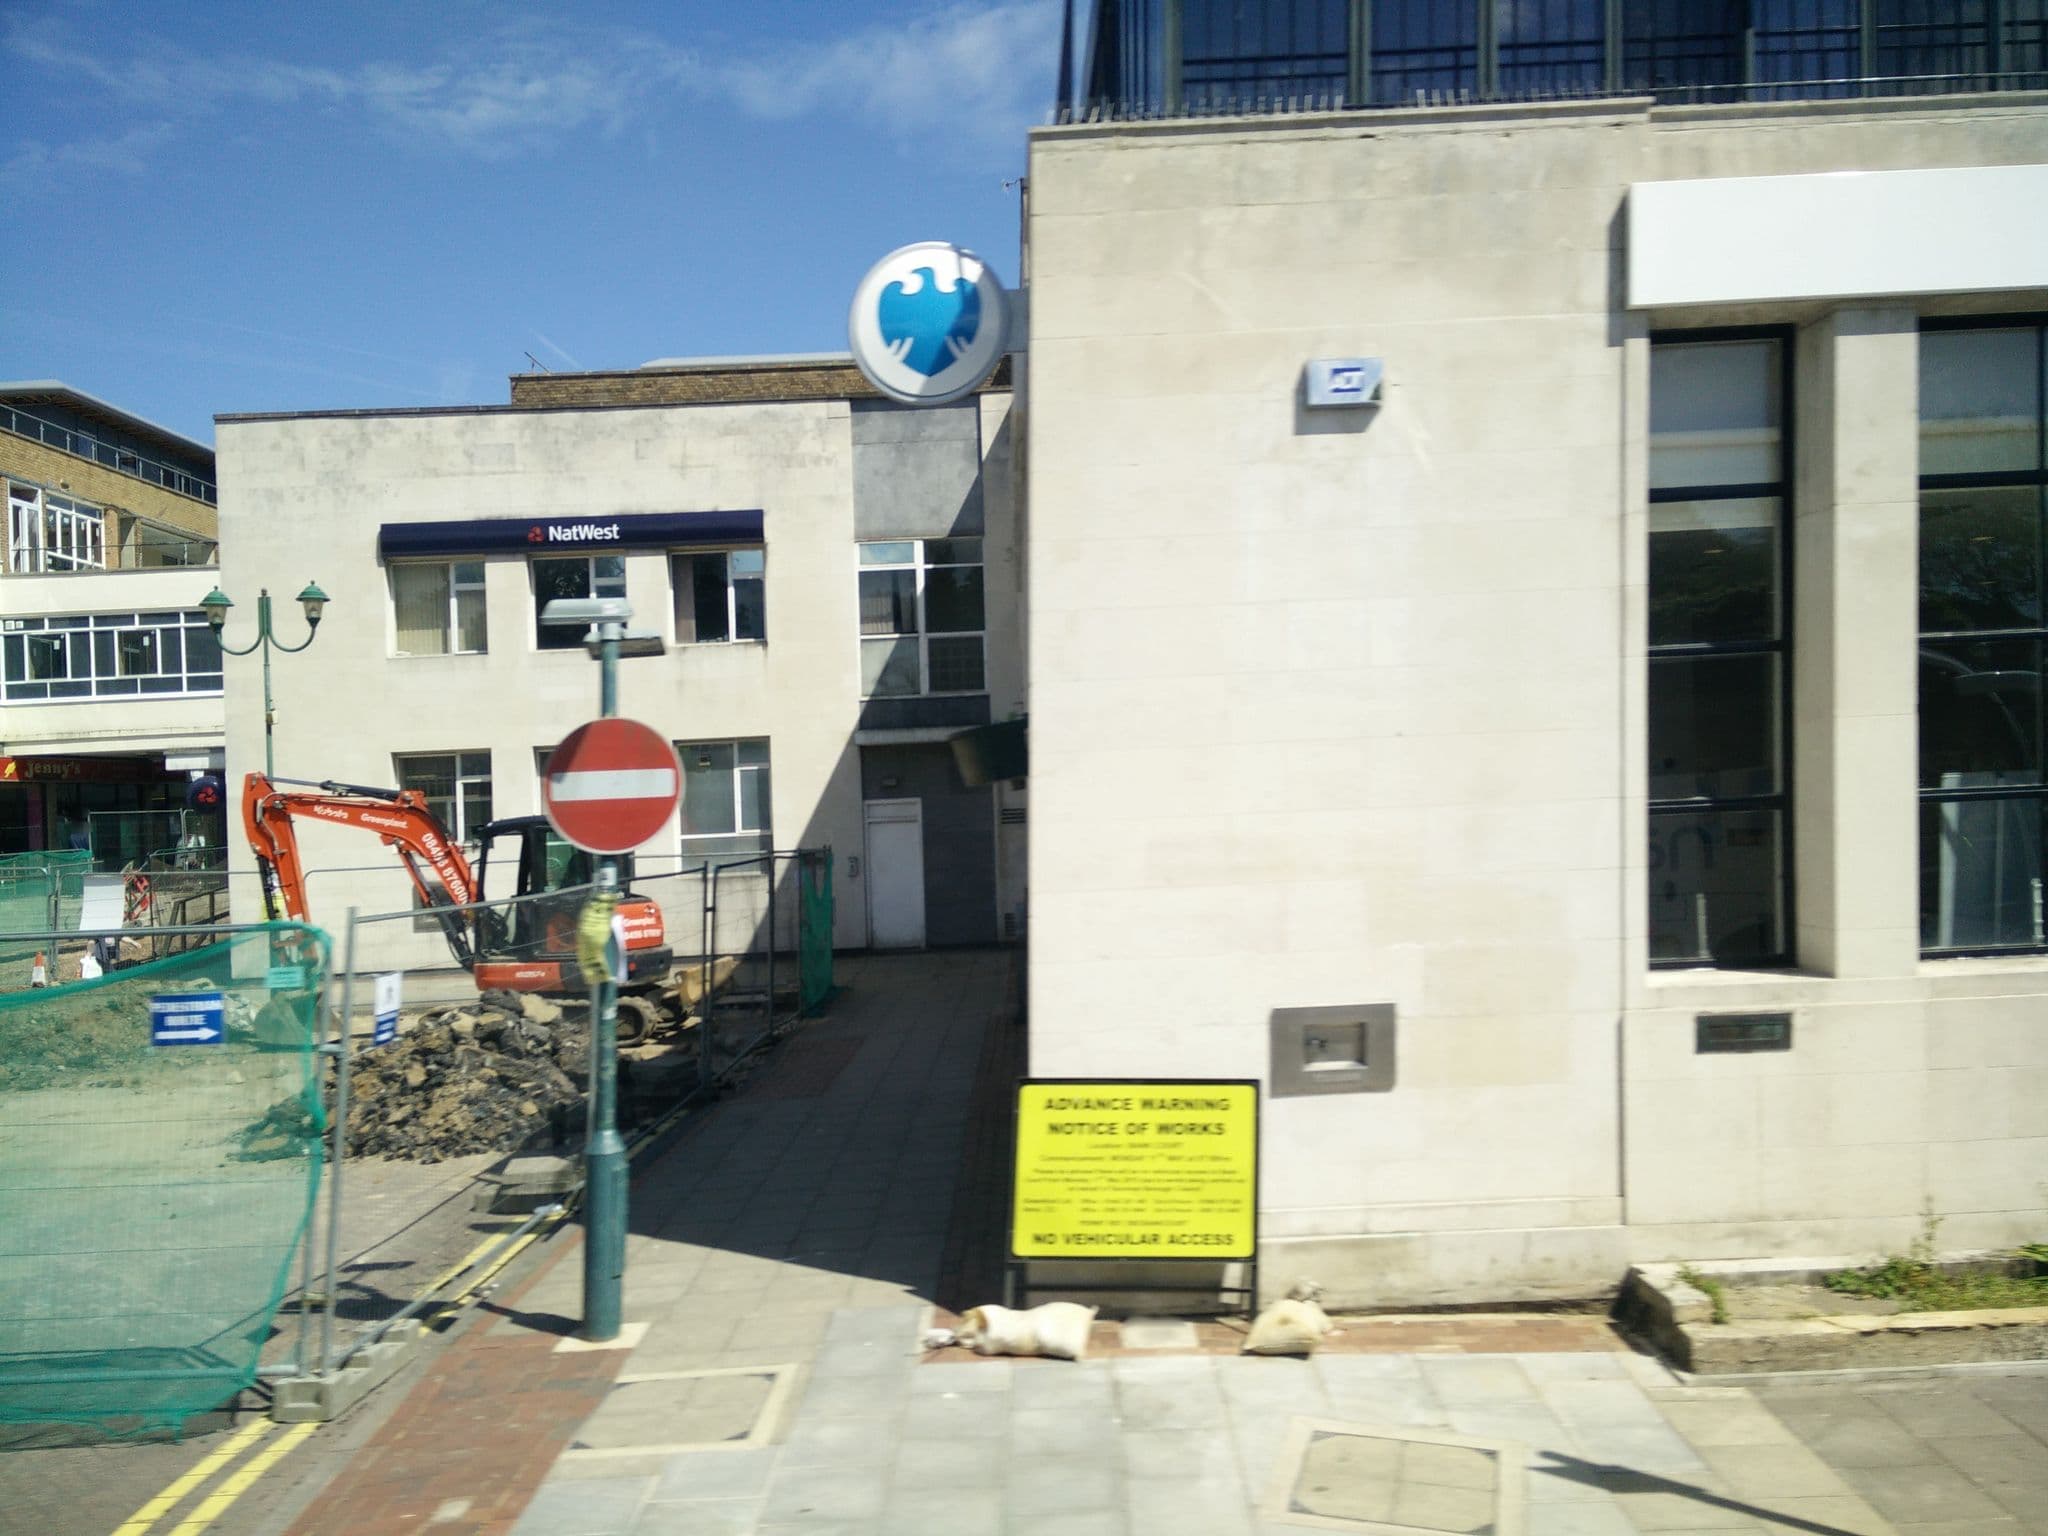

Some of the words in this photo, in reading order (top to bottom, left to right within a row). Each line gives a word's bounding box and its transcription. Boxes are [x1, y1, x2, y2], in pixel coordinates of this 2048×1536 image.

[548, 524, 620, 541] NatWest
[1044, 1098, 1133, 1111] ADVANCE
[1141, 1098, 1231, 1111] WARNING
[1047, 1122, 1118, 1135] NOTICE
[1125, 1122, 1149, 1135] OF
[1157, 1122, 1226, 1135] WORKS
[1032, 1233, 1057, 1245] NO
[1063, 1233, 1160, 1245] VEHICULAR
[1167, 1233, 1235, 1245] ACCESS
